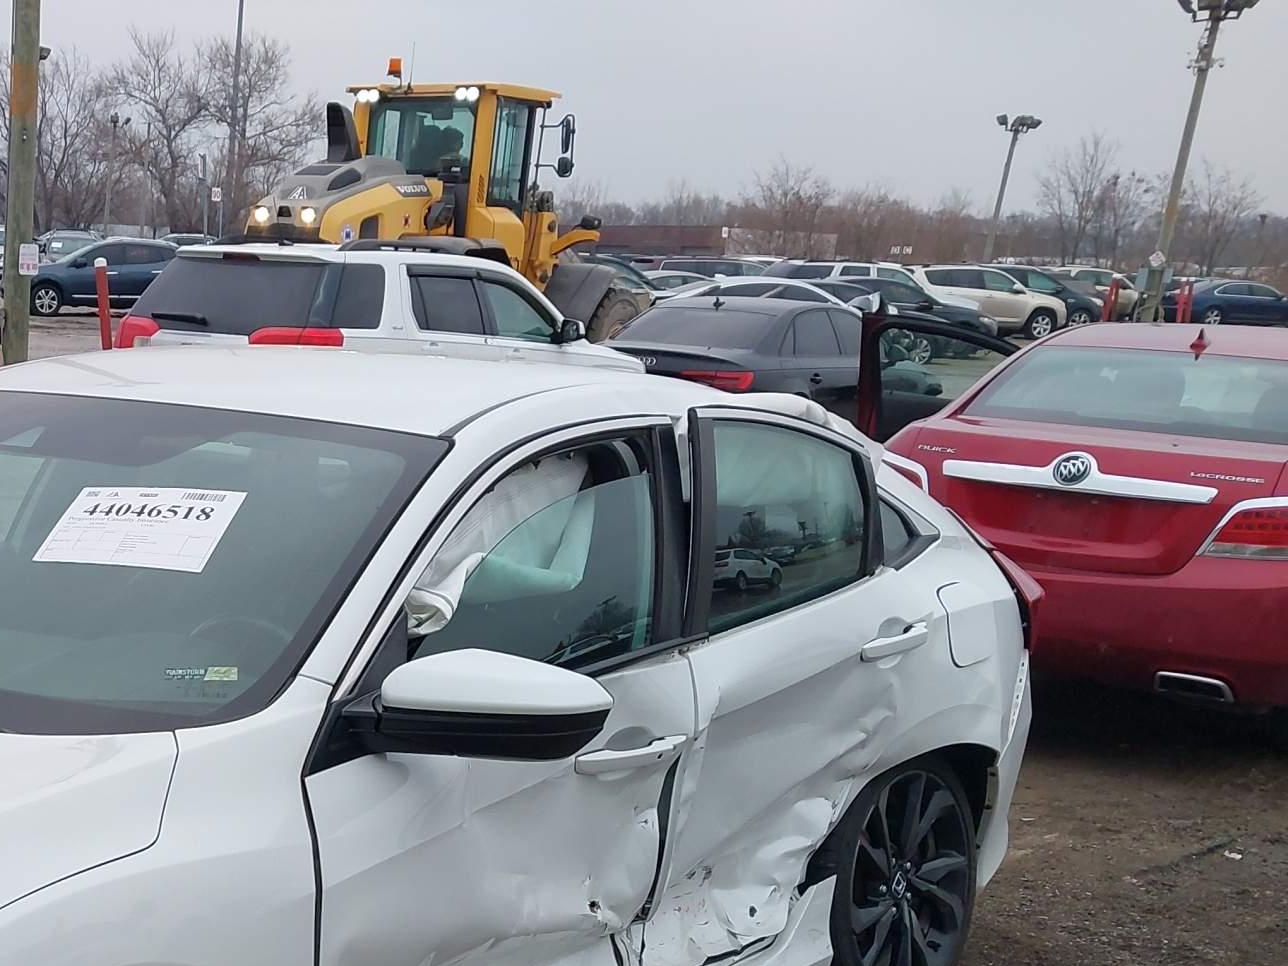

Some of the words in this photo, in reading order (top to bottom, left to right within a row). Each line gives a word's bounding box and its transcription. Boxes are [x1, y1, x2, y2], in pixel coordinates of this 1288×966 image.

[396, 185, 428, 193] VOLVO
[918, 444, 957, 453] BUICK
[83, 502, 215, 521] 44046518
